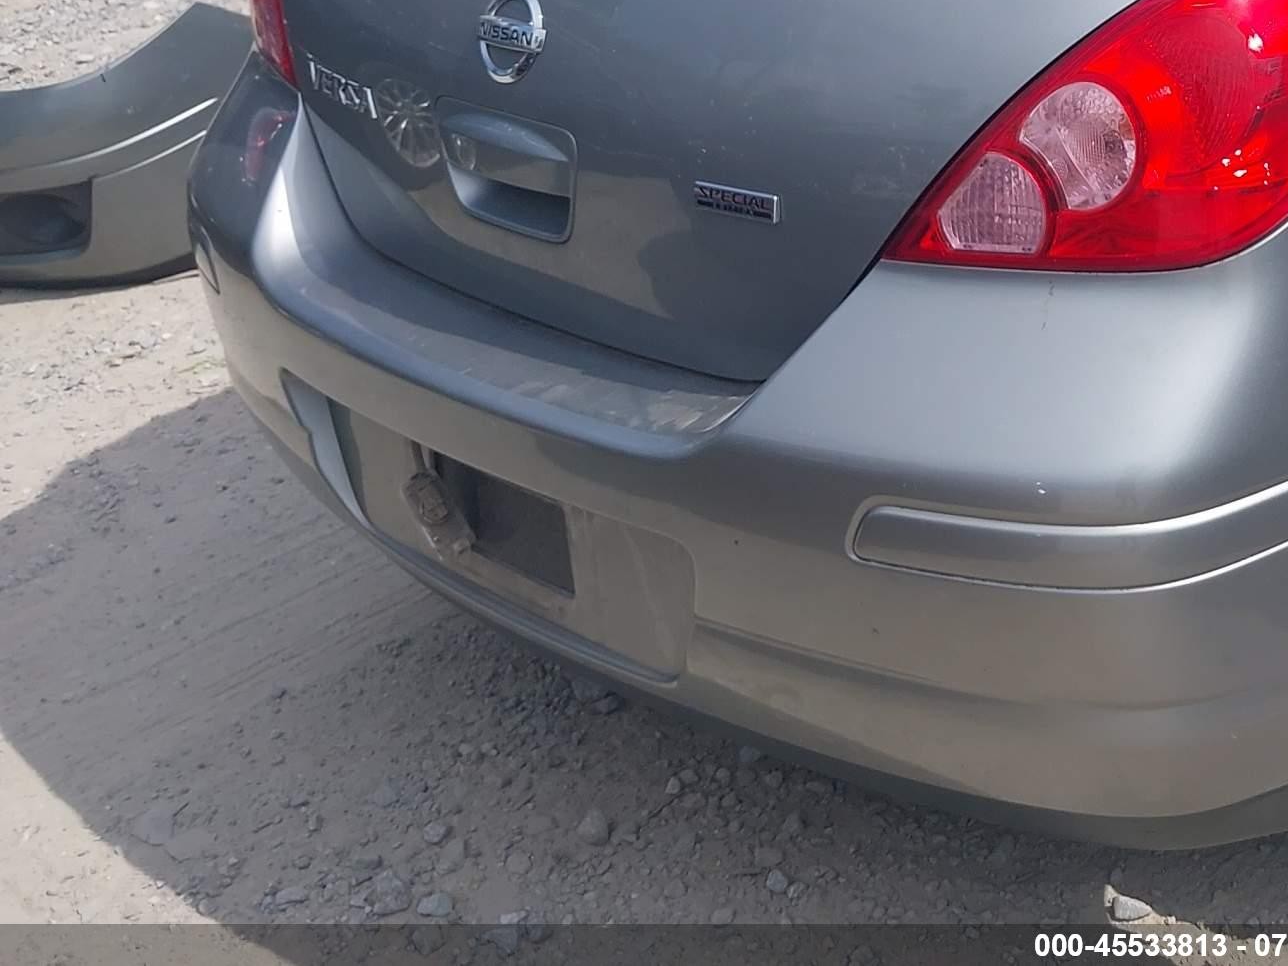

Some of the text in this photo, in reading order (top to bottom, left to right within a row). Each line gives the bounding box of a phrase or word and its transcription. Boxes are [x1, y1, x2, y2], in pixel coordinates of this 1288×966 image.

[480, 20, 535, 46] NISSAN
[306, 52, 378, 119] VERSA
[695, 185, 771, 211] SPECIAL
